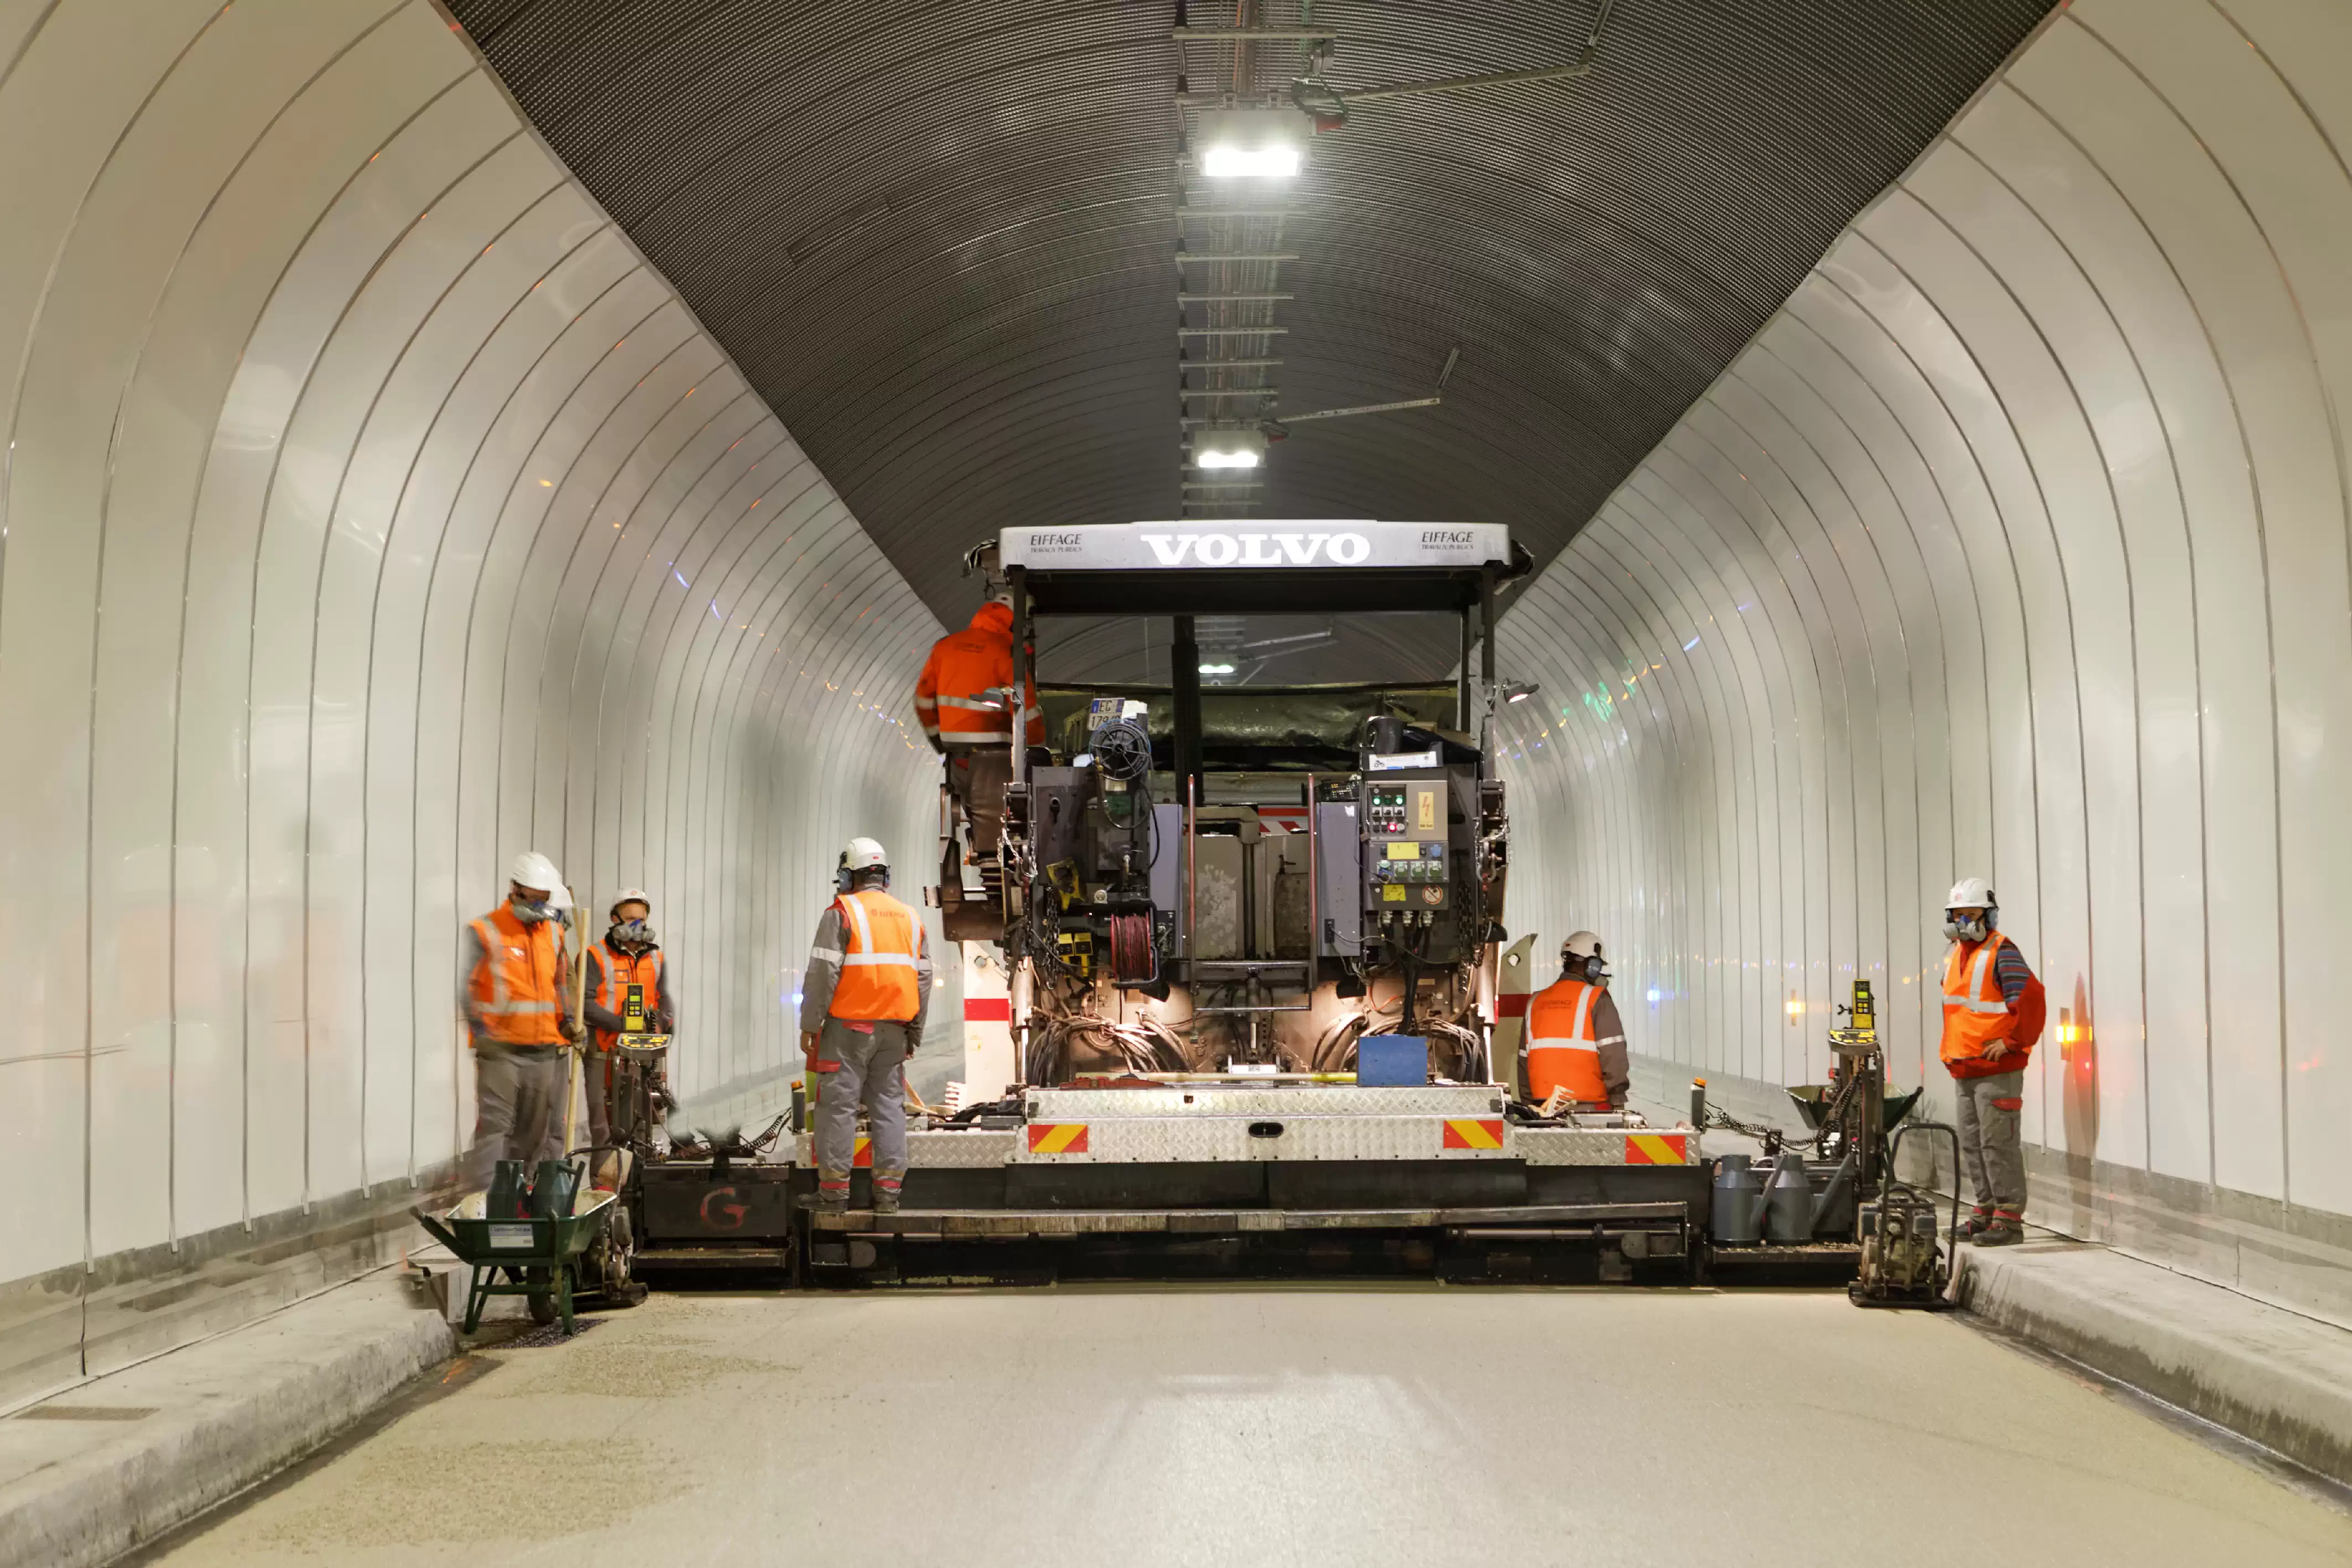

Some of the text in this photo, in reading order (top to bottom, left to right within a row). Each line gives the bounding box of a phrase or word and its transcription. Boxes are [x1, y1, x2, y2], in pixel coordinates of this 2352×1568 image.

[1031, 534, 1083, 545] EIFFAGE
[1422, 531, 1474, 543] EIFFAGE
[1140, 533, 1371, 566] VOLVO
[700, 1186, 751, 1231] G
